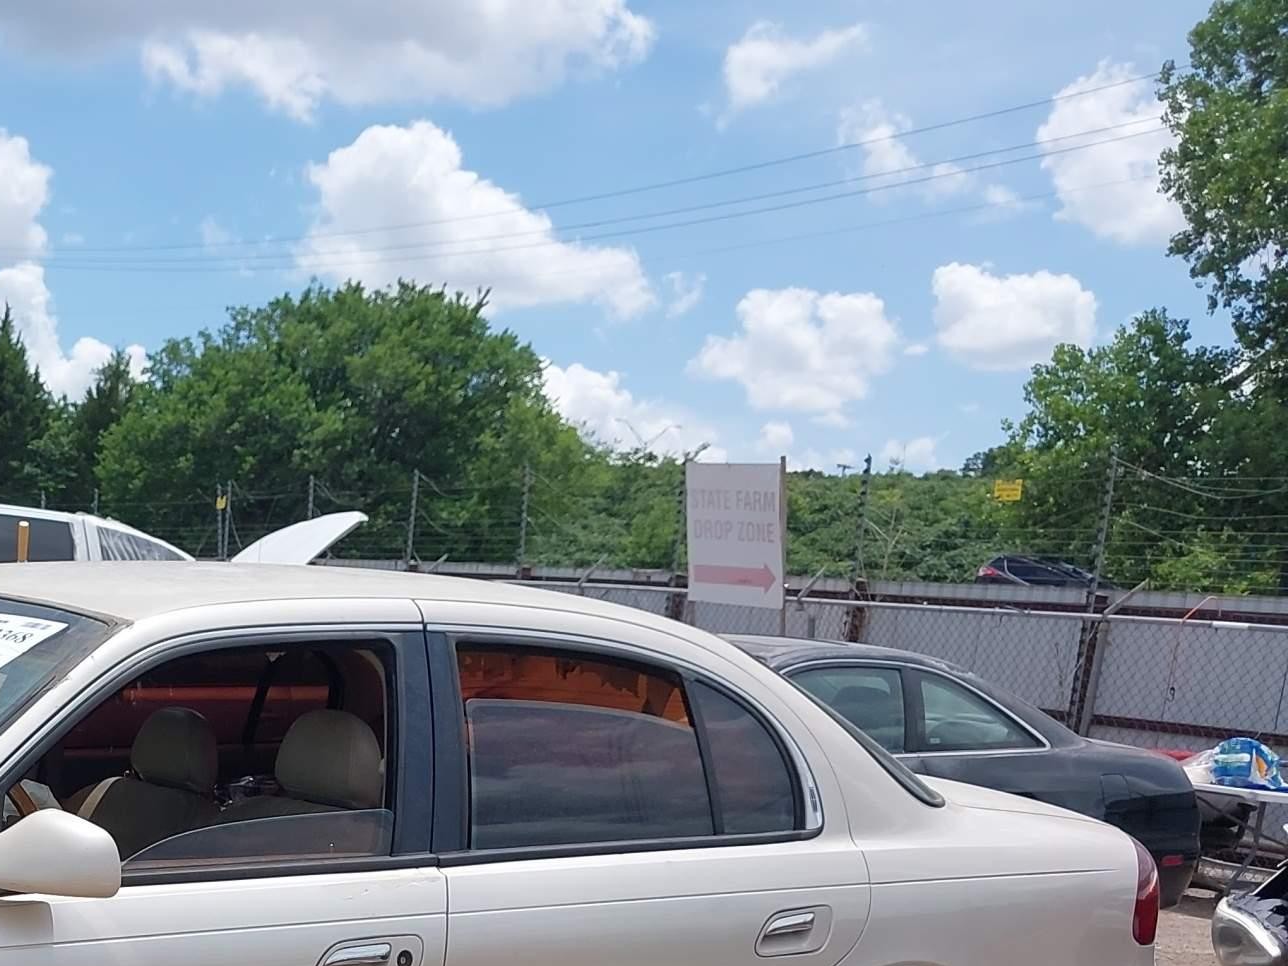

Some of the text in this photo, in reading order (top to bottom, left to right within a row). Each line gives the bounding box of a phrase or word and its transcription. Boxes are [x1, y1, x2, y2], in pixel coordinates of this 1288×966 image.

[692, 489, 777, 513] STATE FARM
[693, 519, 776, 544] DROP ZONE
